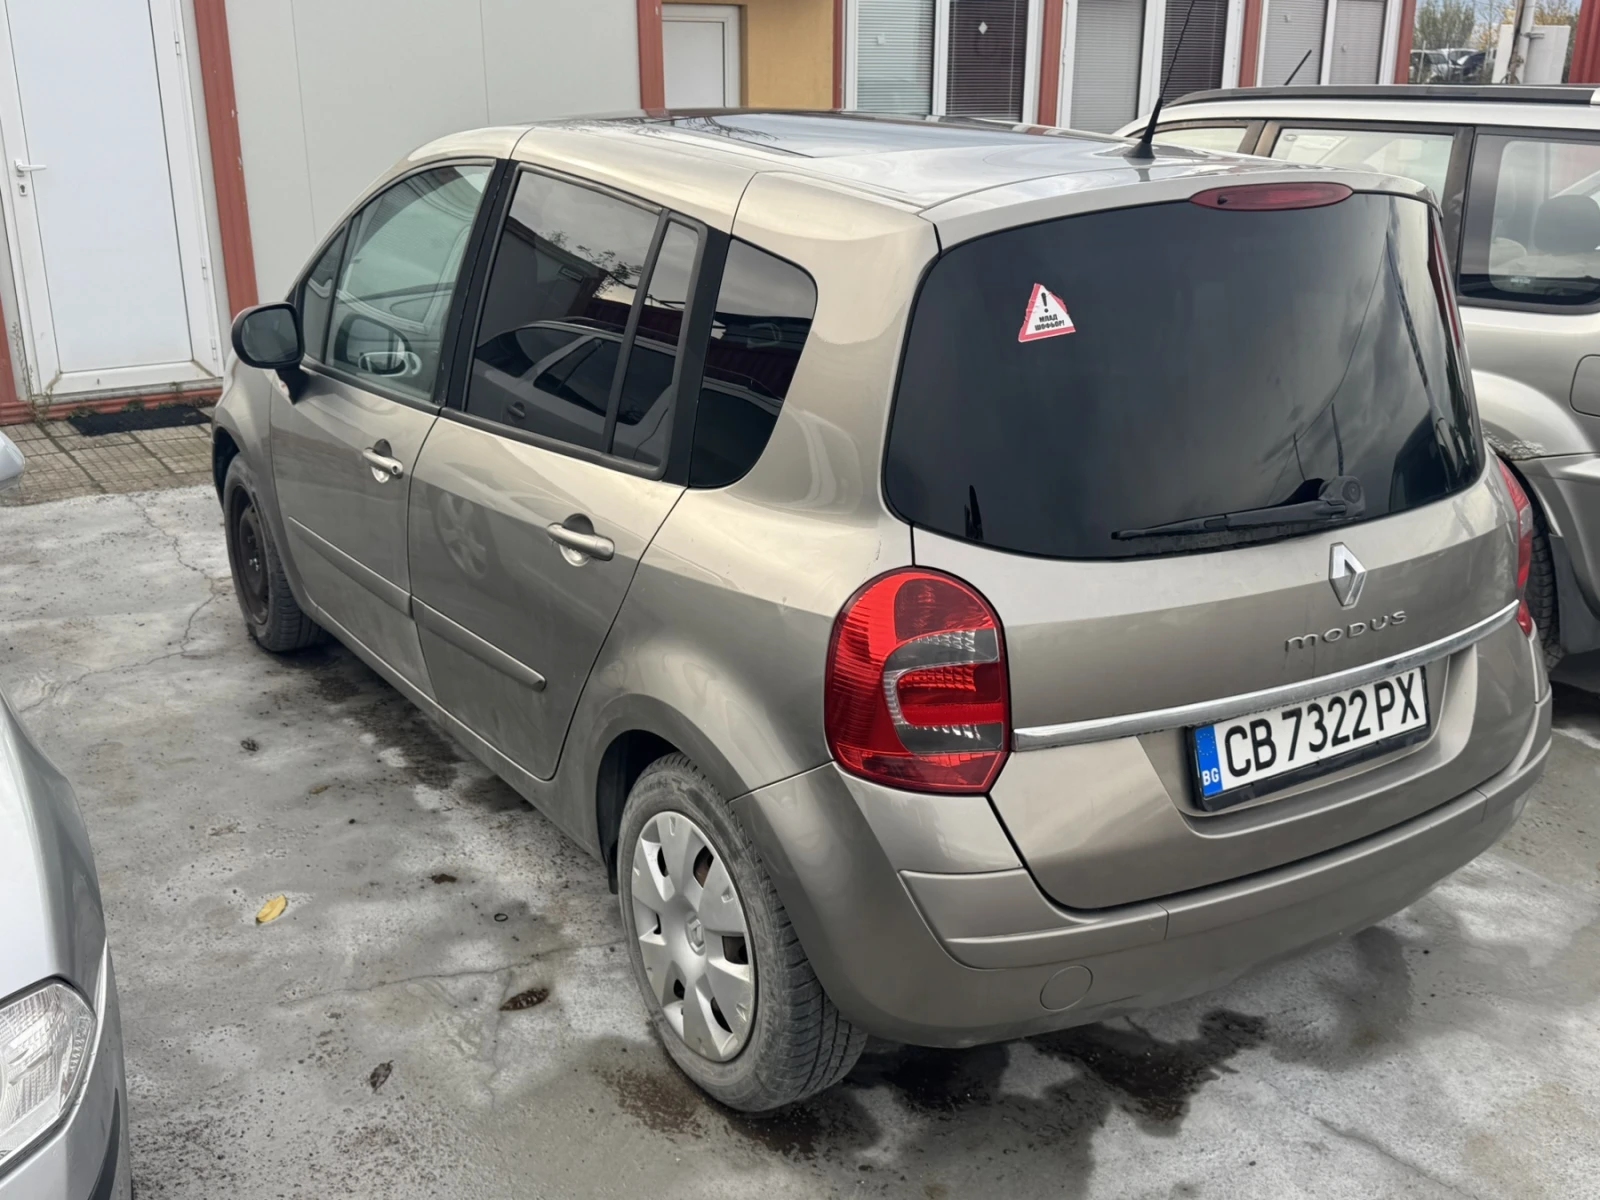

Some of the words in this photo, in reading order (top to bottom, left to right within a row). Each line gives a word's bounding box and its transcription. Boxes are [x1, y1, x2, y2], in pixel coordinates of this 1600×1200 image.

[1039, 314, 1058, 322] МЛАД
[1281, 689, 1371, 762] 7322
[1202, 767, 1220, 786] BG
